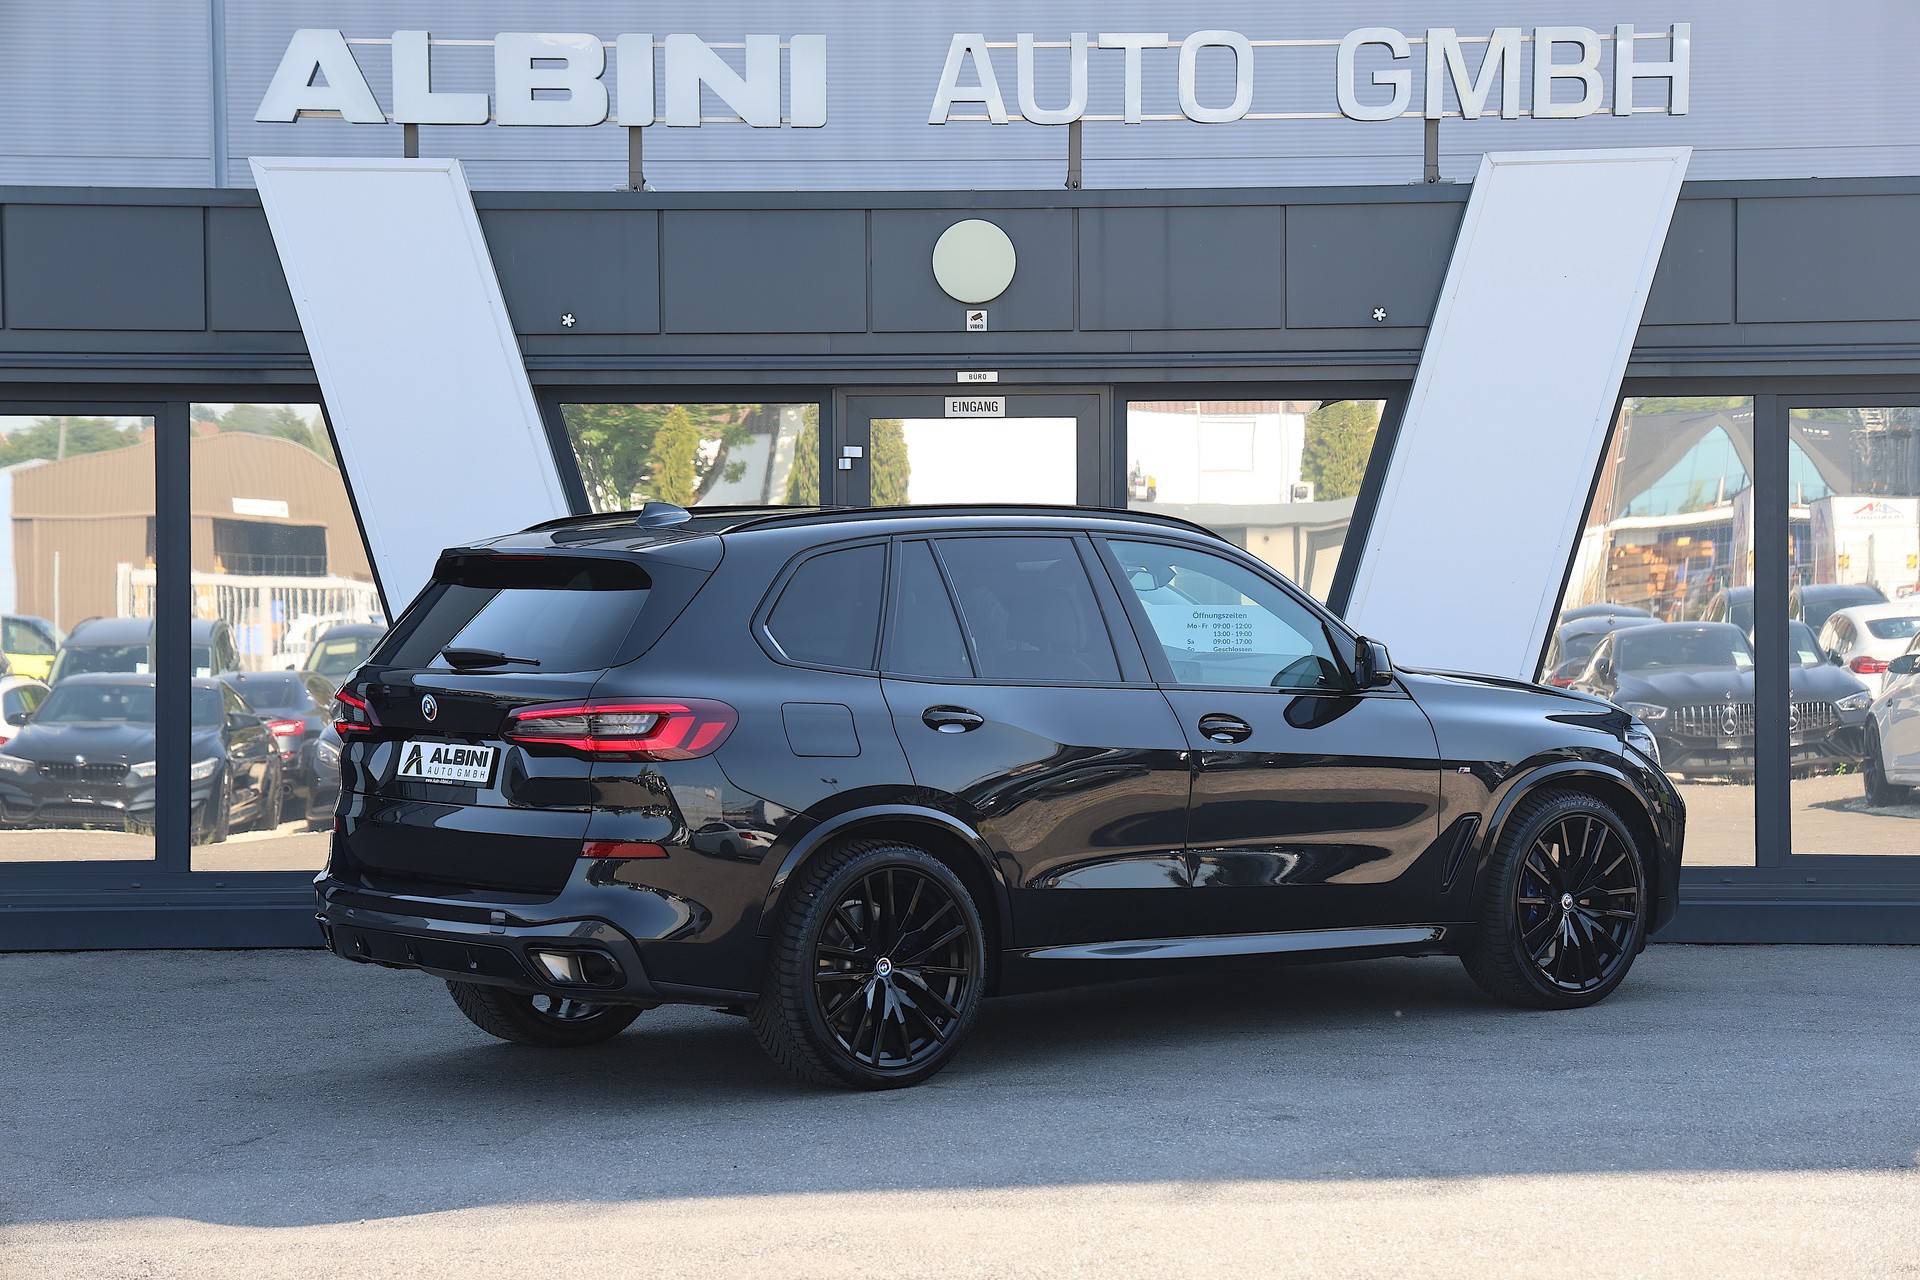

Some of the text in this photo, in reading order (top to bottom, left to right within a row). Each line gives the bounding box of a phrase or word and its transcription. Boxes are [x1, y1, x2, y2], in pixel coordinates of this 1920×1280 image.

[254, 22, 1691, 128] ALBINI AUTO GMBH
[952, 401, 998, 412] EINGANG
[1192, 611, 1248, 620] Öffnungszeiten
[430, 748, 489, 767] ALBINI
[427, 766, 486, 778] AUTO GMBH
